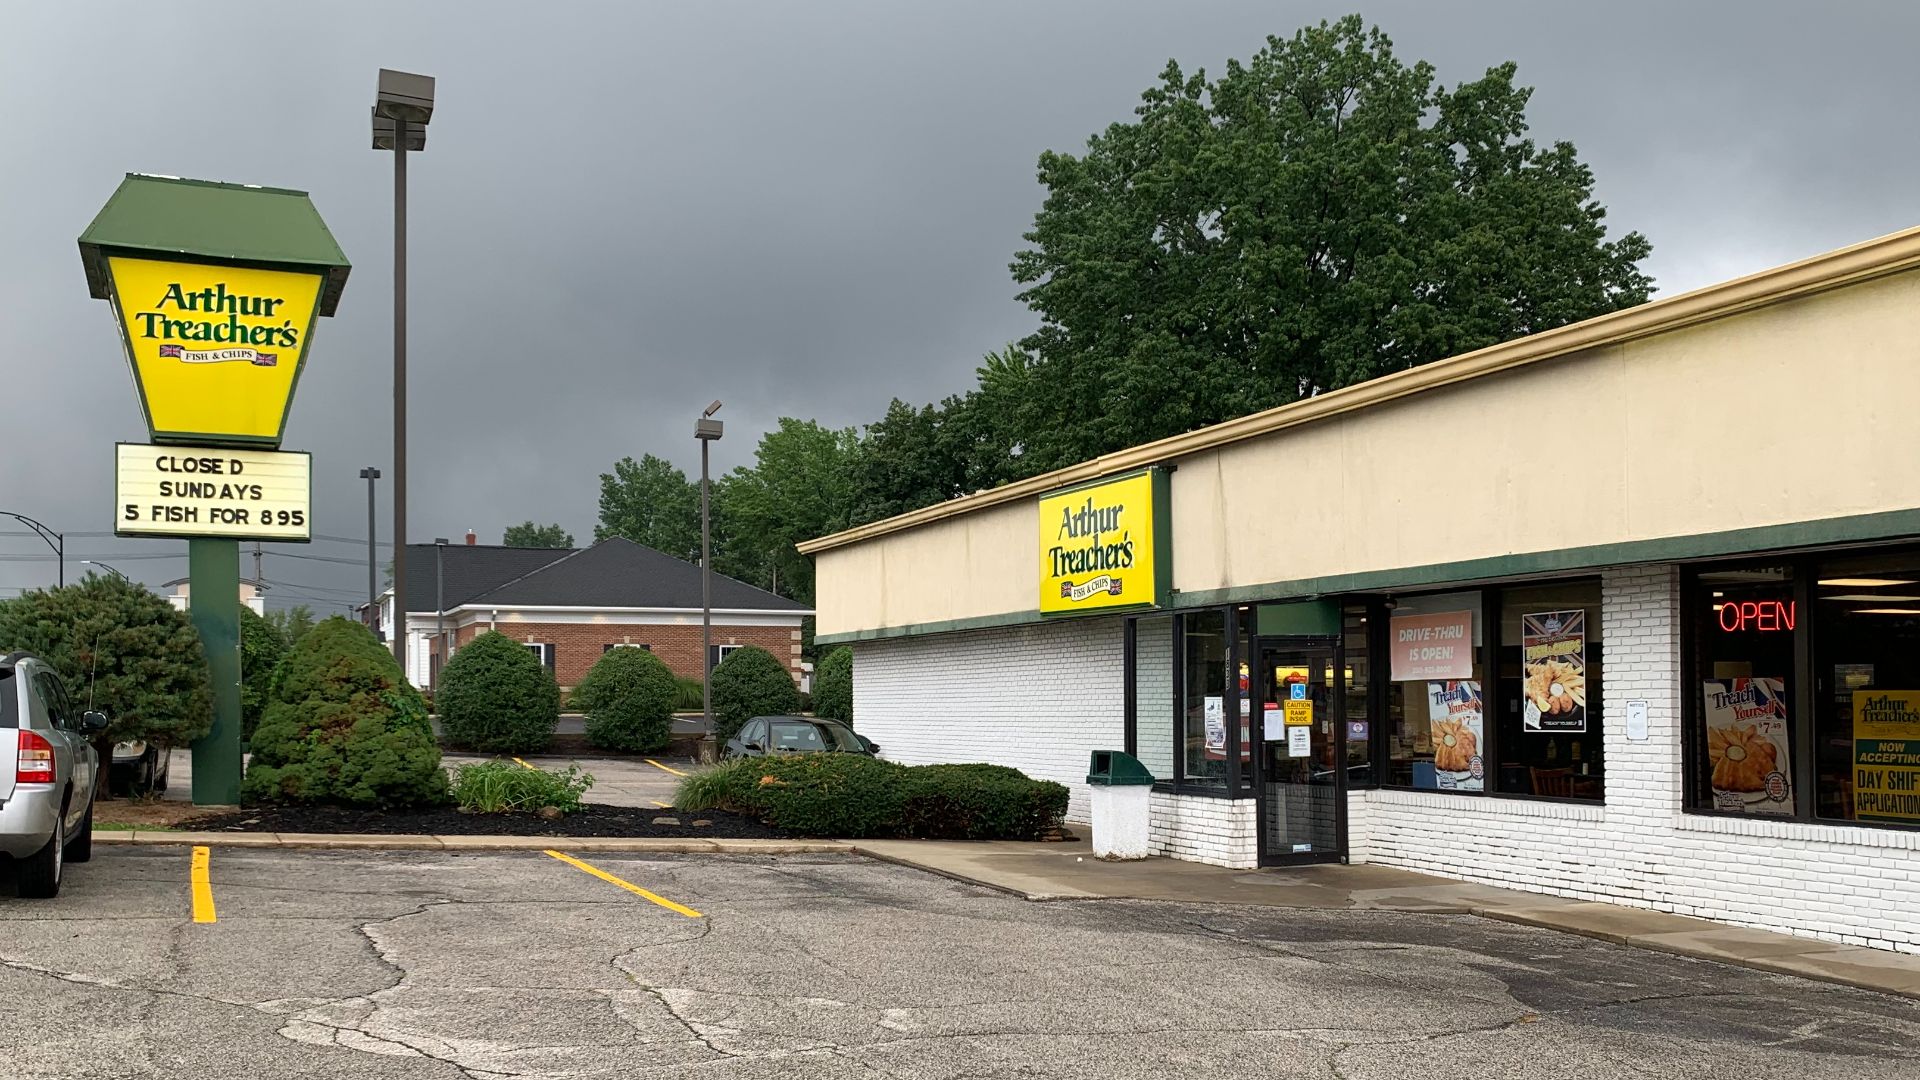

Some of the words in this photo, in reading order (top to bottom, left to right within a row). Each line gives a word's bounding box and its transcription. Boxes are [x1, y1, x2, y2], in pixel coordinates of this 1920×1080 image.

[156, 283, 285, 317] Arthur
[135, 312, 298, 348] Treacher's
[184, 351, 208, 361] FISH
[212, 351, 220, 360] &
[221, 350, 253, 361] CHIPS
[159, 482, 262, 500] SUNDAYS
[125, 505, 139, 520] 5
[152, 505, 198, 522] FISH
[210, 508, 249, 525] FOR
[1058, 497, 1124, 540] Arthur
[1049, 531, 1133, 577] Treacher's
[1073, 586, 1086, 598] FISH
[1086, 585, 1091, 594] &
[1091, 577, 1109, 592] CHIPS
[1720, 601, 1795, 631] OPEN
[1399, 625, 1464, 642] DRIVE-THRU
[1409, 648, 1419, 661] IS
[1421, 647, 1454, 660] OPEN!
[1878, 742, 1906, 752] NOW
[1857, 769, 1883, 789] DAY
